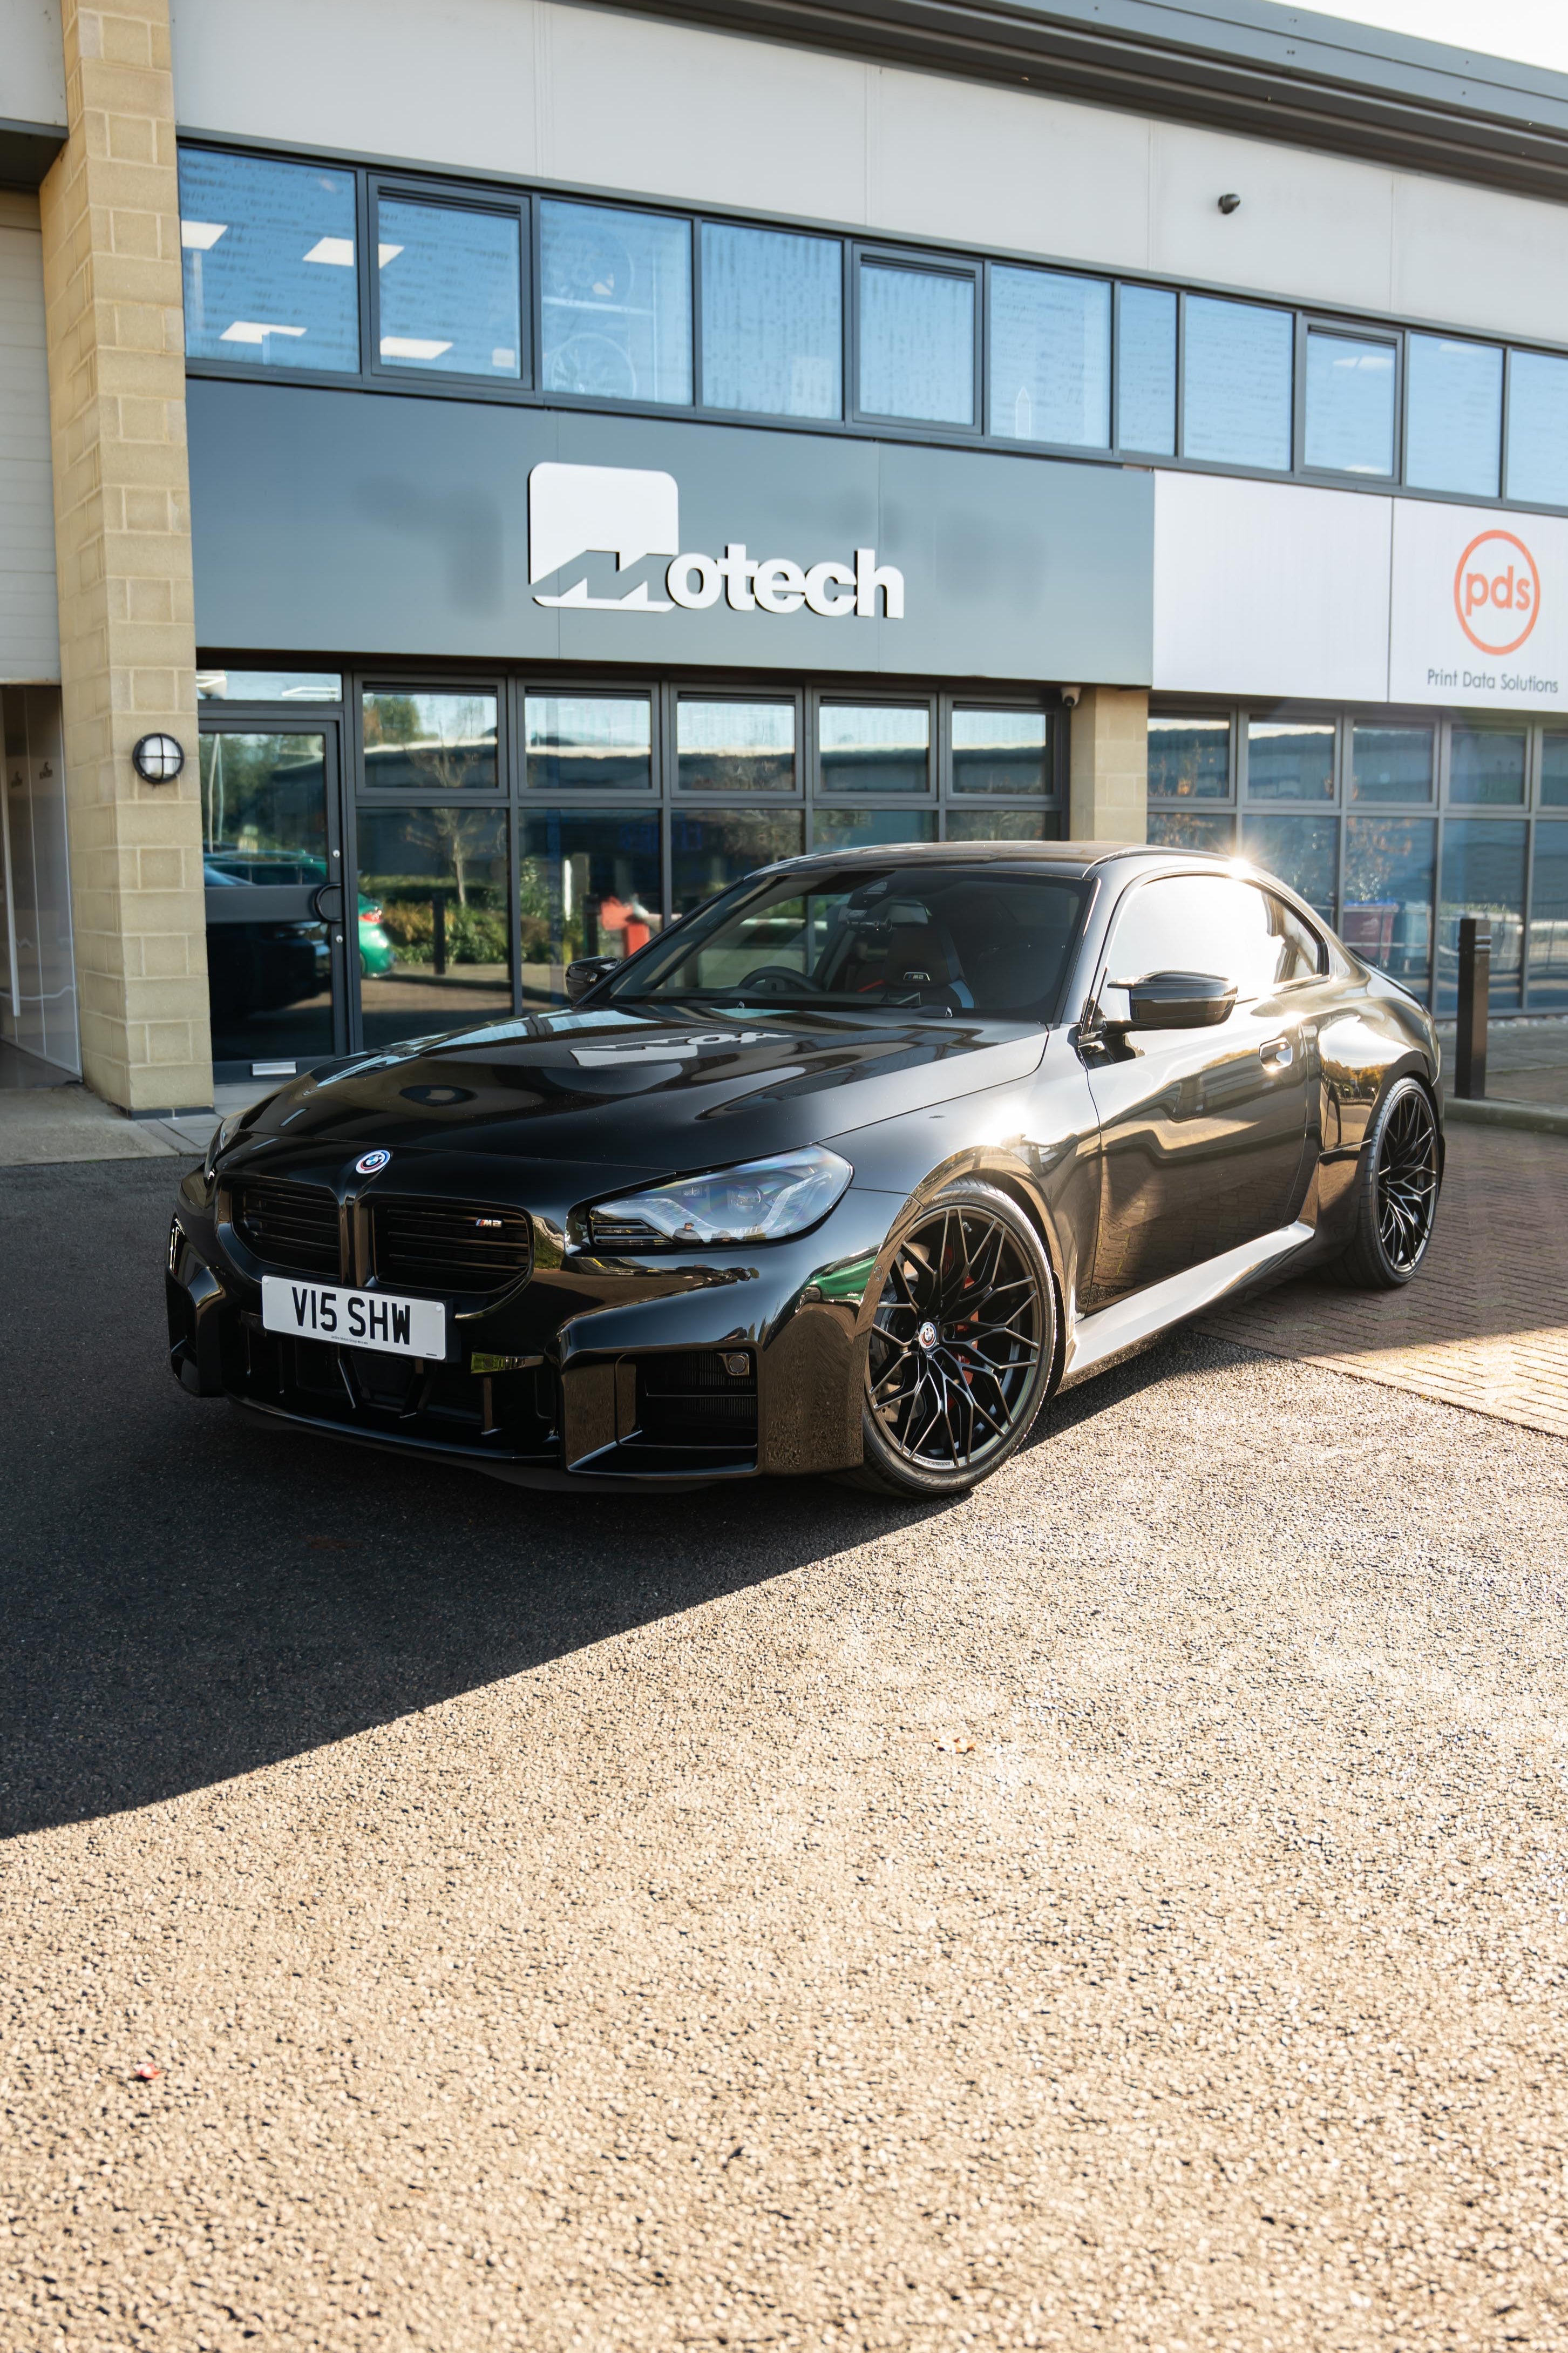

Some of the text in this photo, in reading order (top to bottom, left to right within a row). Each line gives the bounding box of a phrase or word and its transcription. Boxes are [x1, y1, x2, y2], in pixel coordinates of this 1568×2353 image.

[1465, 565, 1531, 617] pds
[1427, 668, 1559, 694] Print Data Solutions
[291, 1286, 411, 1345] V15 SHW
